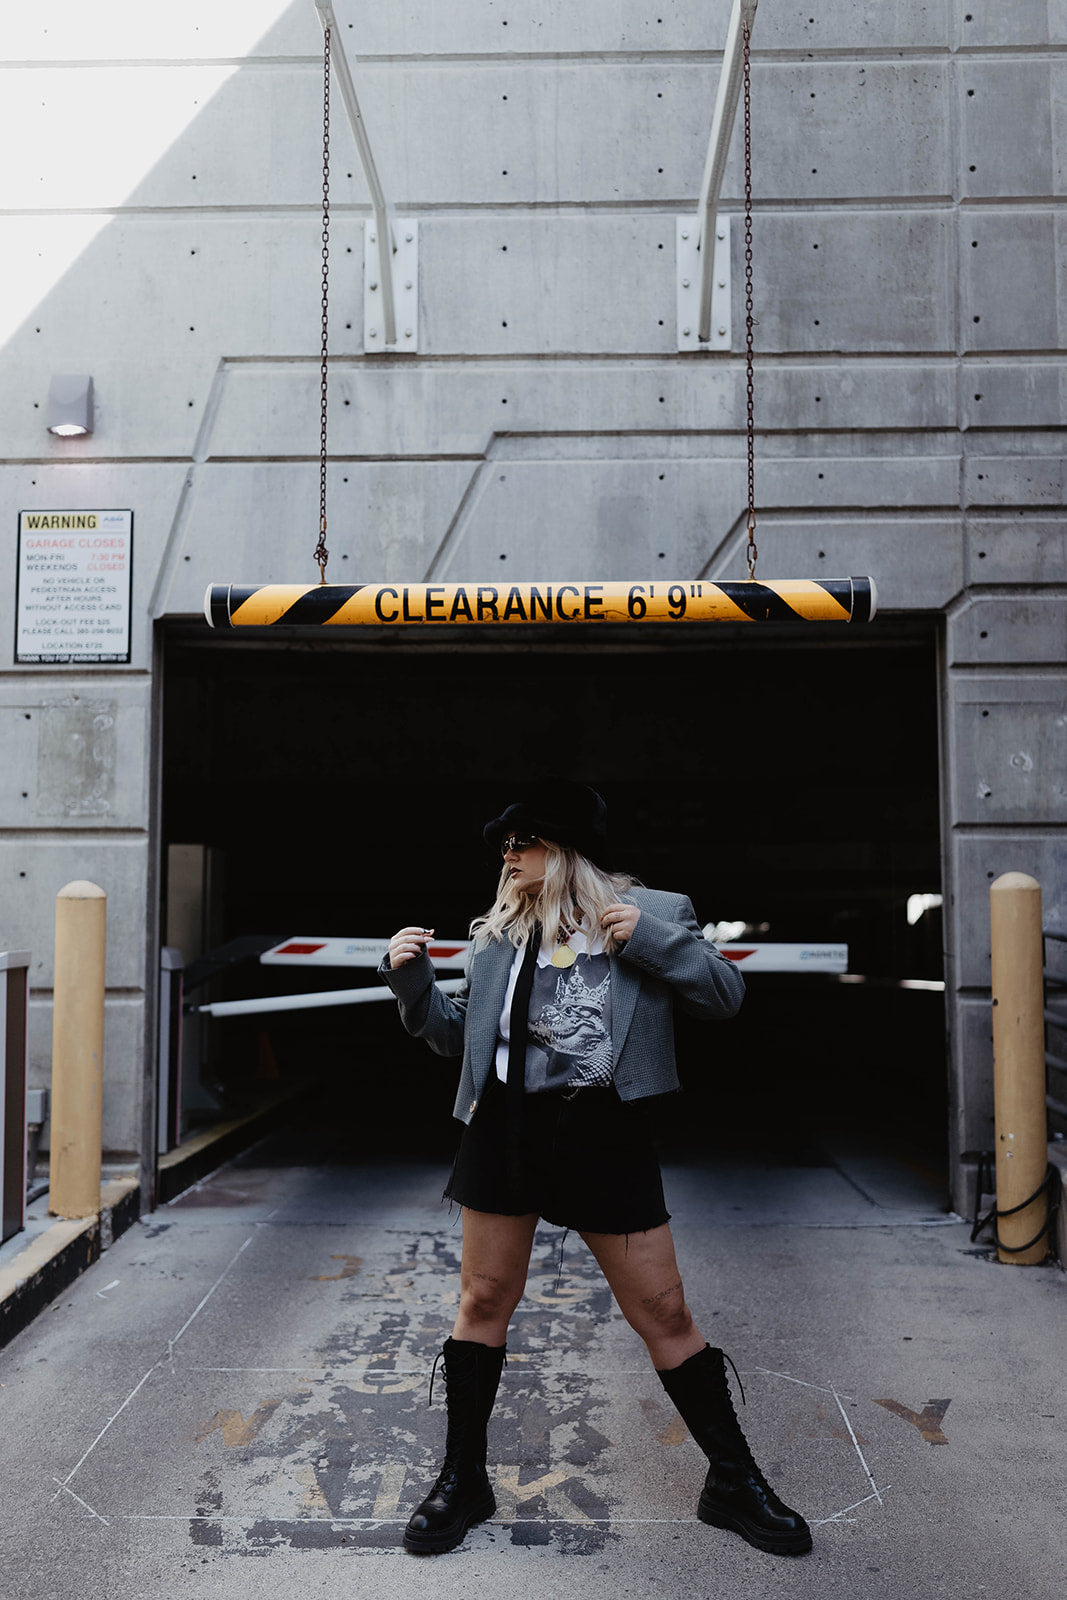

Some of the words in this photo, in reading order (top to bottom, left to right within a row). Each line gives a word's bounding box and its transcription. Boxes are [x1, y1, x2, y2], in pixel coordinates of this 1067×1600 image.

[27, 515, 97, 529] WARNING
[26, 539, 75, 548] GARAGE
[78, 539, 125, 548] CLOSES
[111, 553, 125, 561] PM
[26, 563, 78, 571] WEEKENDS
[87, 563, 125, 571] CLOSED
[84, 585, 117, 593] ACCESS
[64, 603, 97, 611] ACCESS
[374, 585, 606, 623] CLEARANCE
[627, 584, 655, 620] 6'
